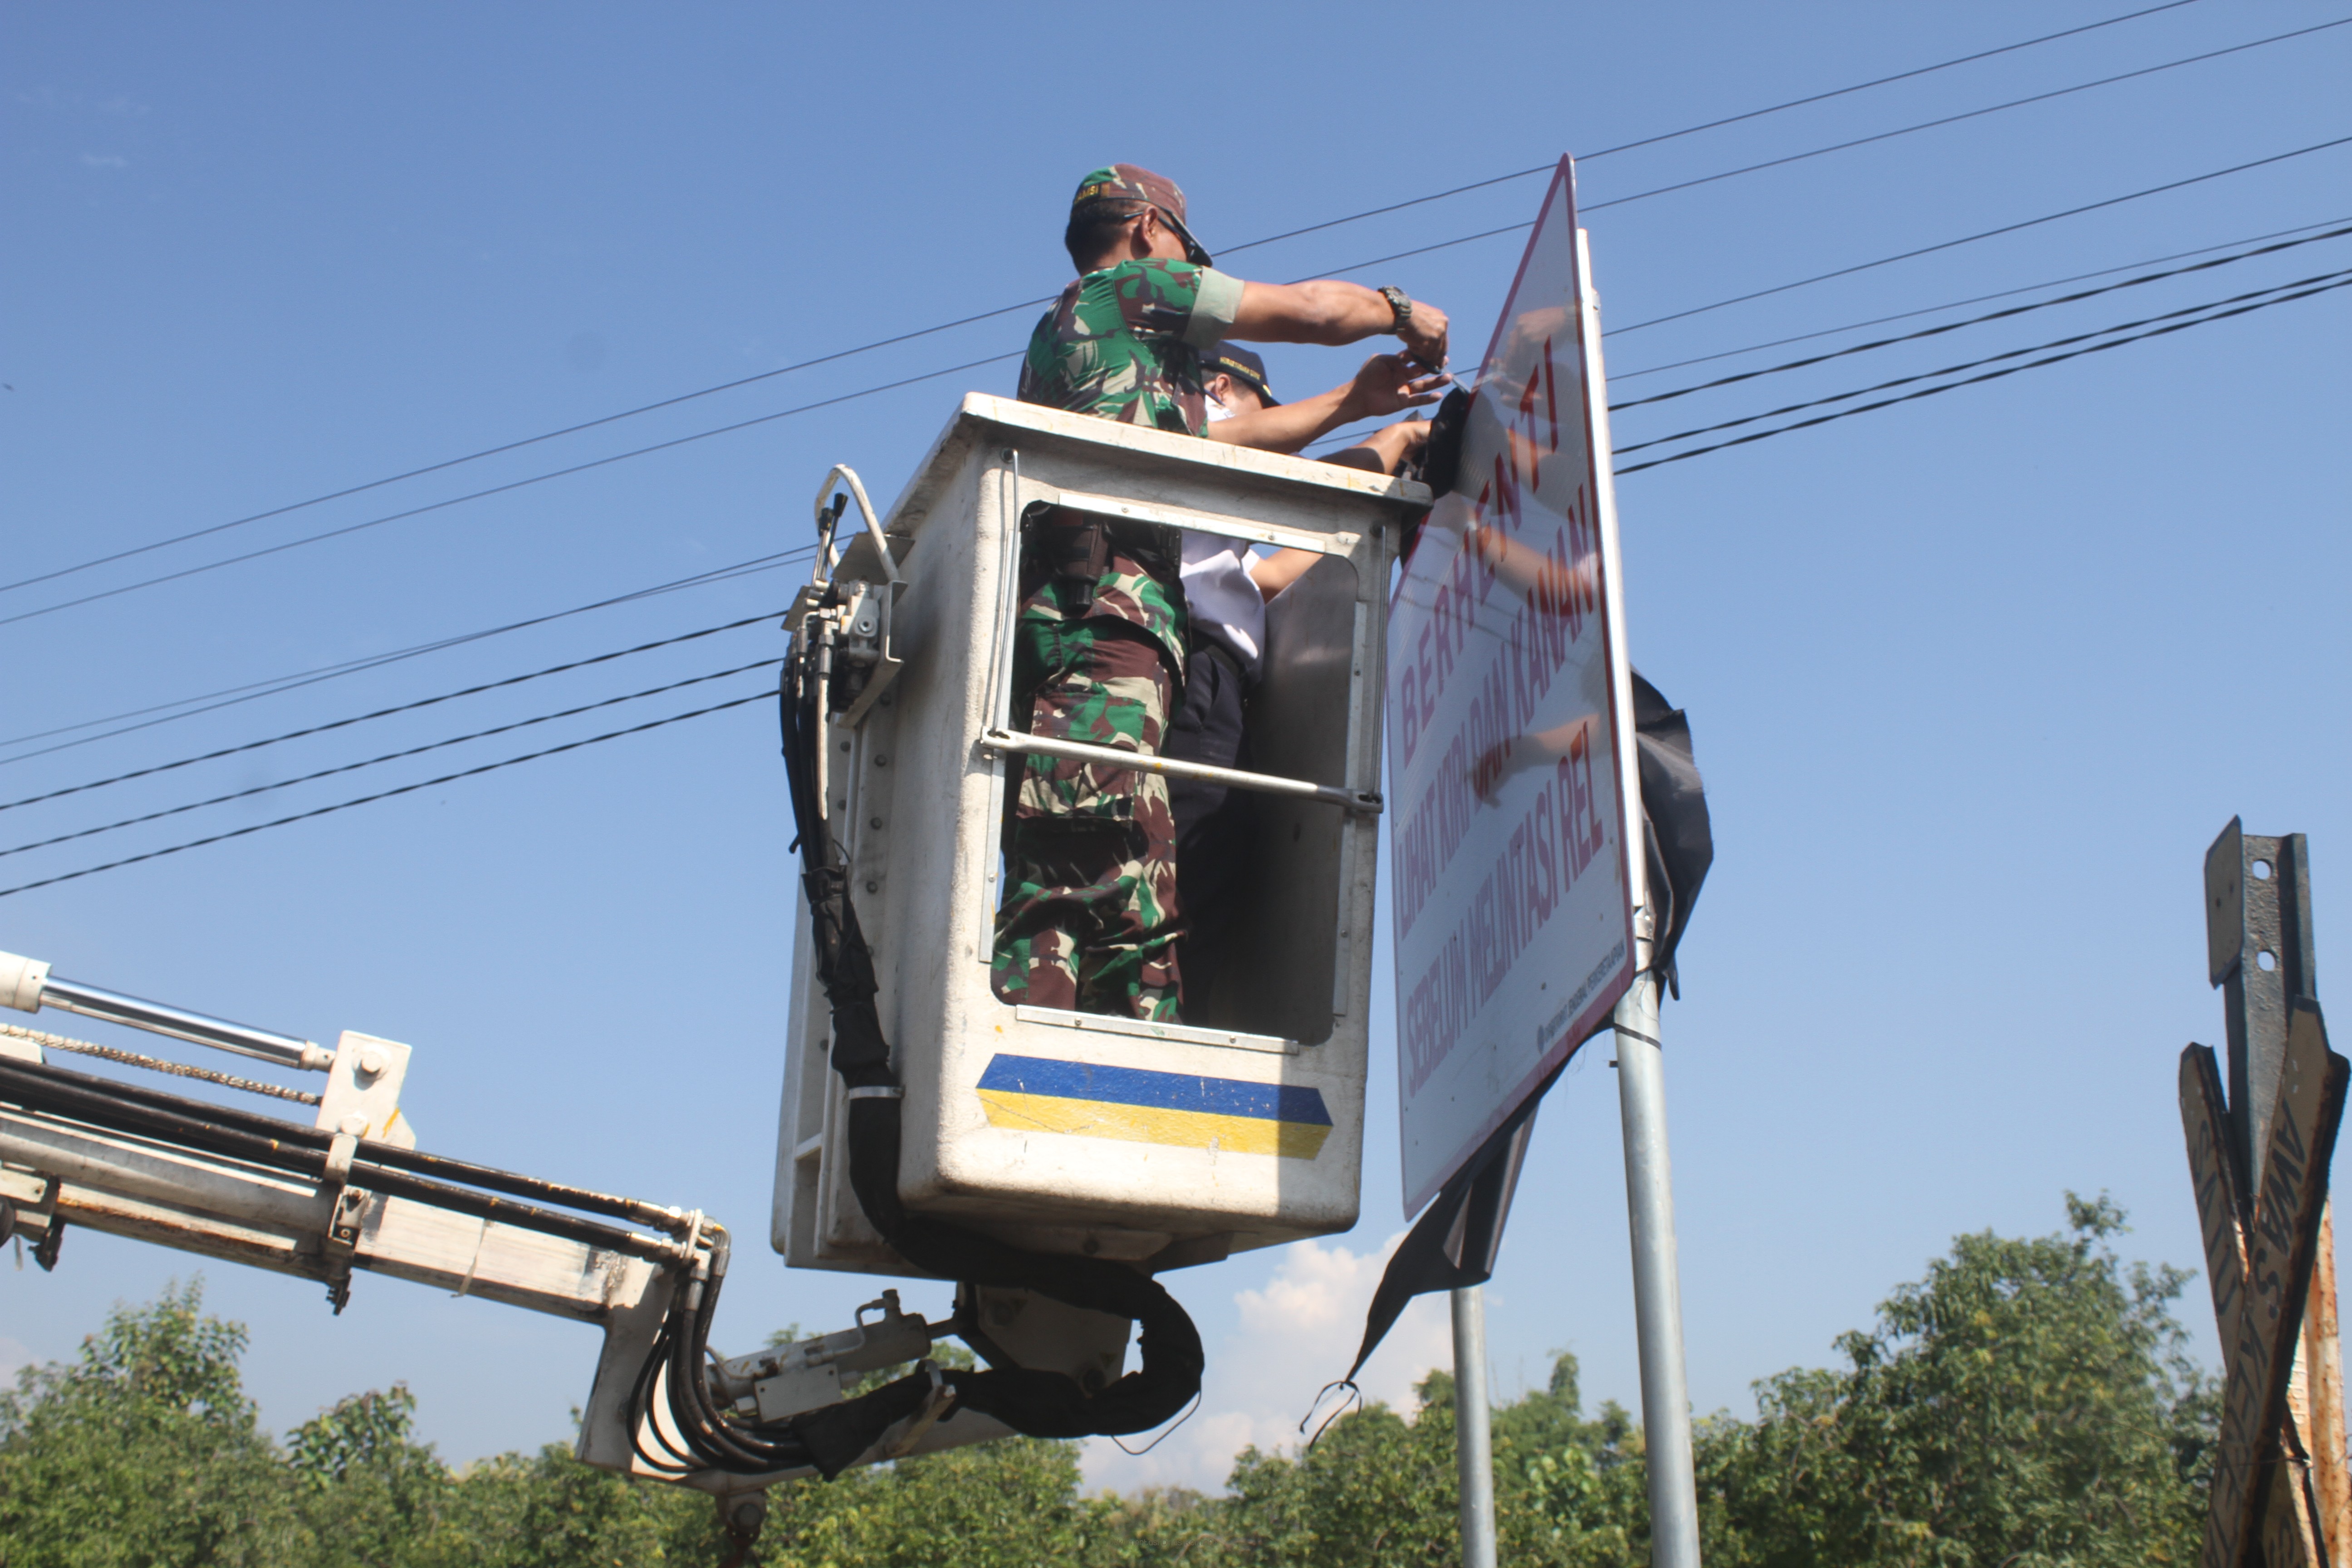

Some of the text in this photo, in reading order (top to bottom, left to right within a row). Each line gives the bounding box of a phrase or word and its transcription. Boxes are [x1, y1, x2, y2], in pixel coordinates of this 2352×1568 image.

[1399, 482, 1593, 941] LIHAT KIRI DAN KANAN
[1401, 335, 1559, 770] BERHENTI
[1407, 720, 1603, 1099] SEBELUM MELINTASI REL
[2254, 1097, 2305, 1319] AWAS
